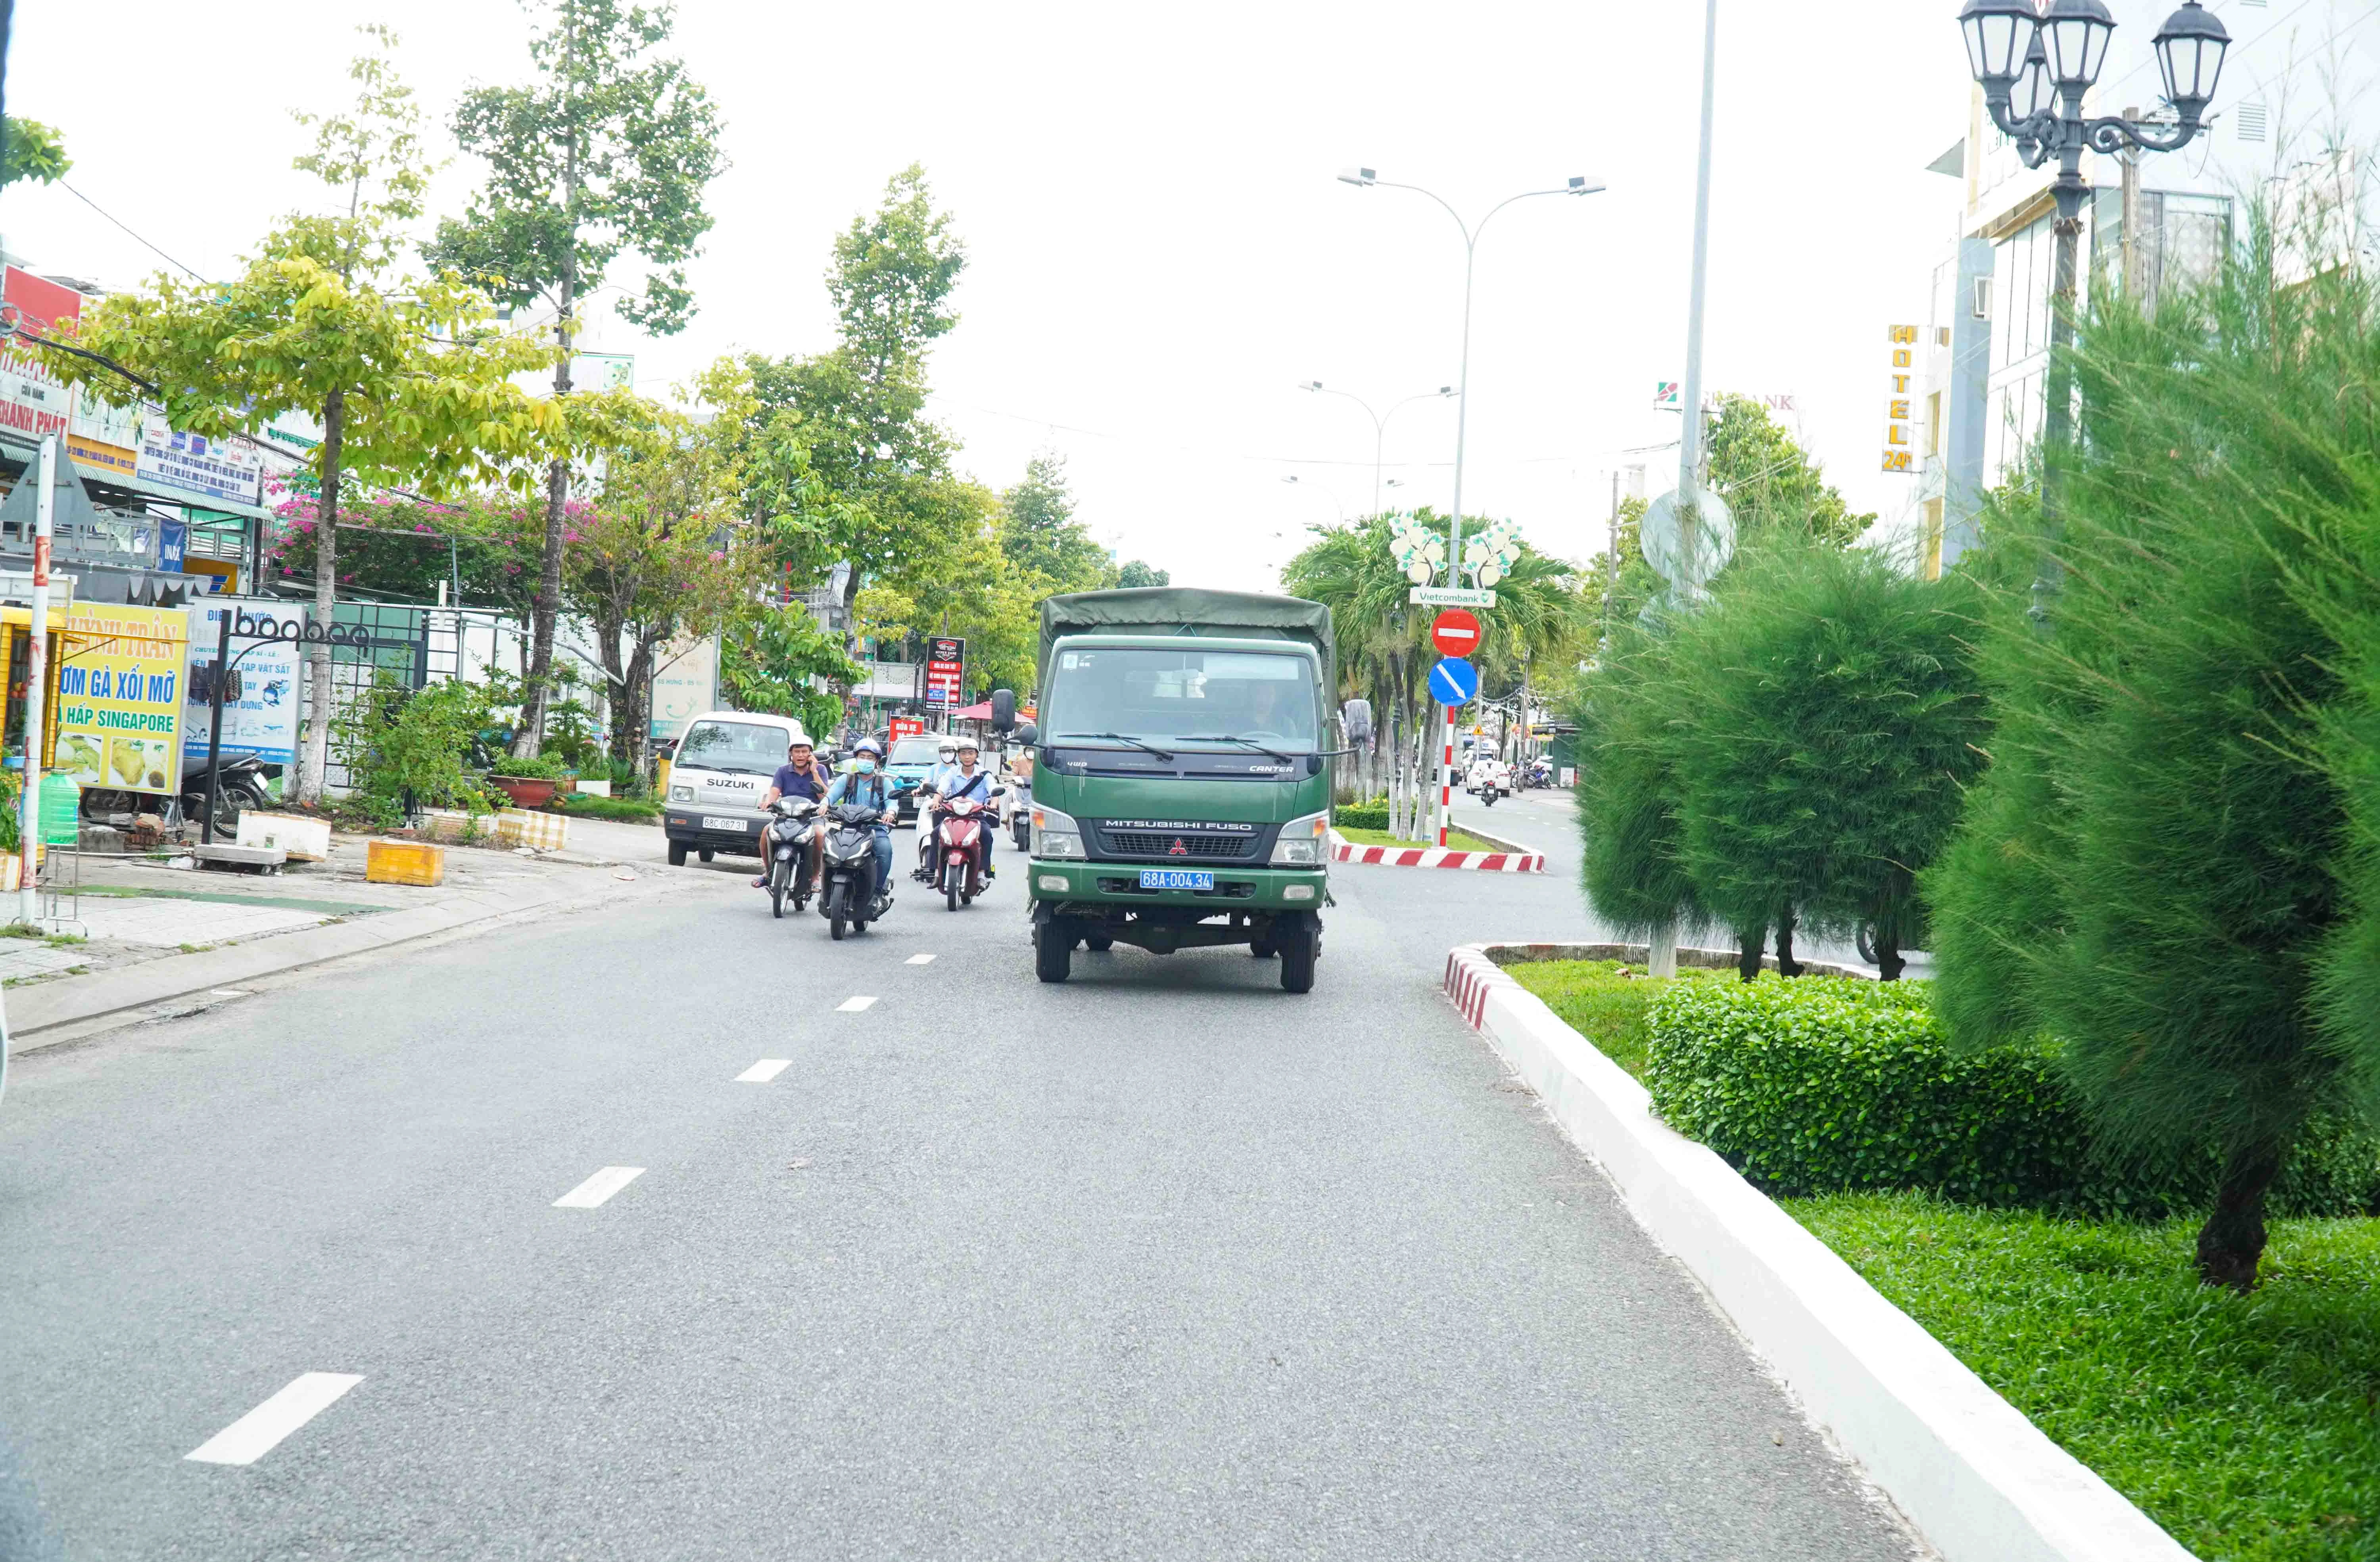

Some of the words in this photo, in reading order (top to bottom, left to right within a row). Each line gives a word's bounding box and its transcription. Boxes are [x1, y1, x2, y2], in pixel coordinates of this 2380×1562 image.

[1889, 325, 1914, 445] HOTEL
[35, 409, 66, 438] PHÁT
[1420, 592, 1478, 603] Vietcombank
[65, 609, 121, 655] UỲNH
[126, 613, 178, 660] TRÂN
[60, 665, 86, 695] ƠM
[90, 666, 111, 698] GÀ
[116, 664, 143, 701] XỐI
[148, 670, 175, 704] MỠ
[67, 702, 93, 725] HẤP
[98, 710, 175, 733] SINGAPORE
[896, 722, 908, 731] RỬA
[707, 779, 754, 789] SUZUKI
[1106, 820, 1200, 829] MITSUBISHI
[1143, 872, 1210, 887] 68A-004.34
